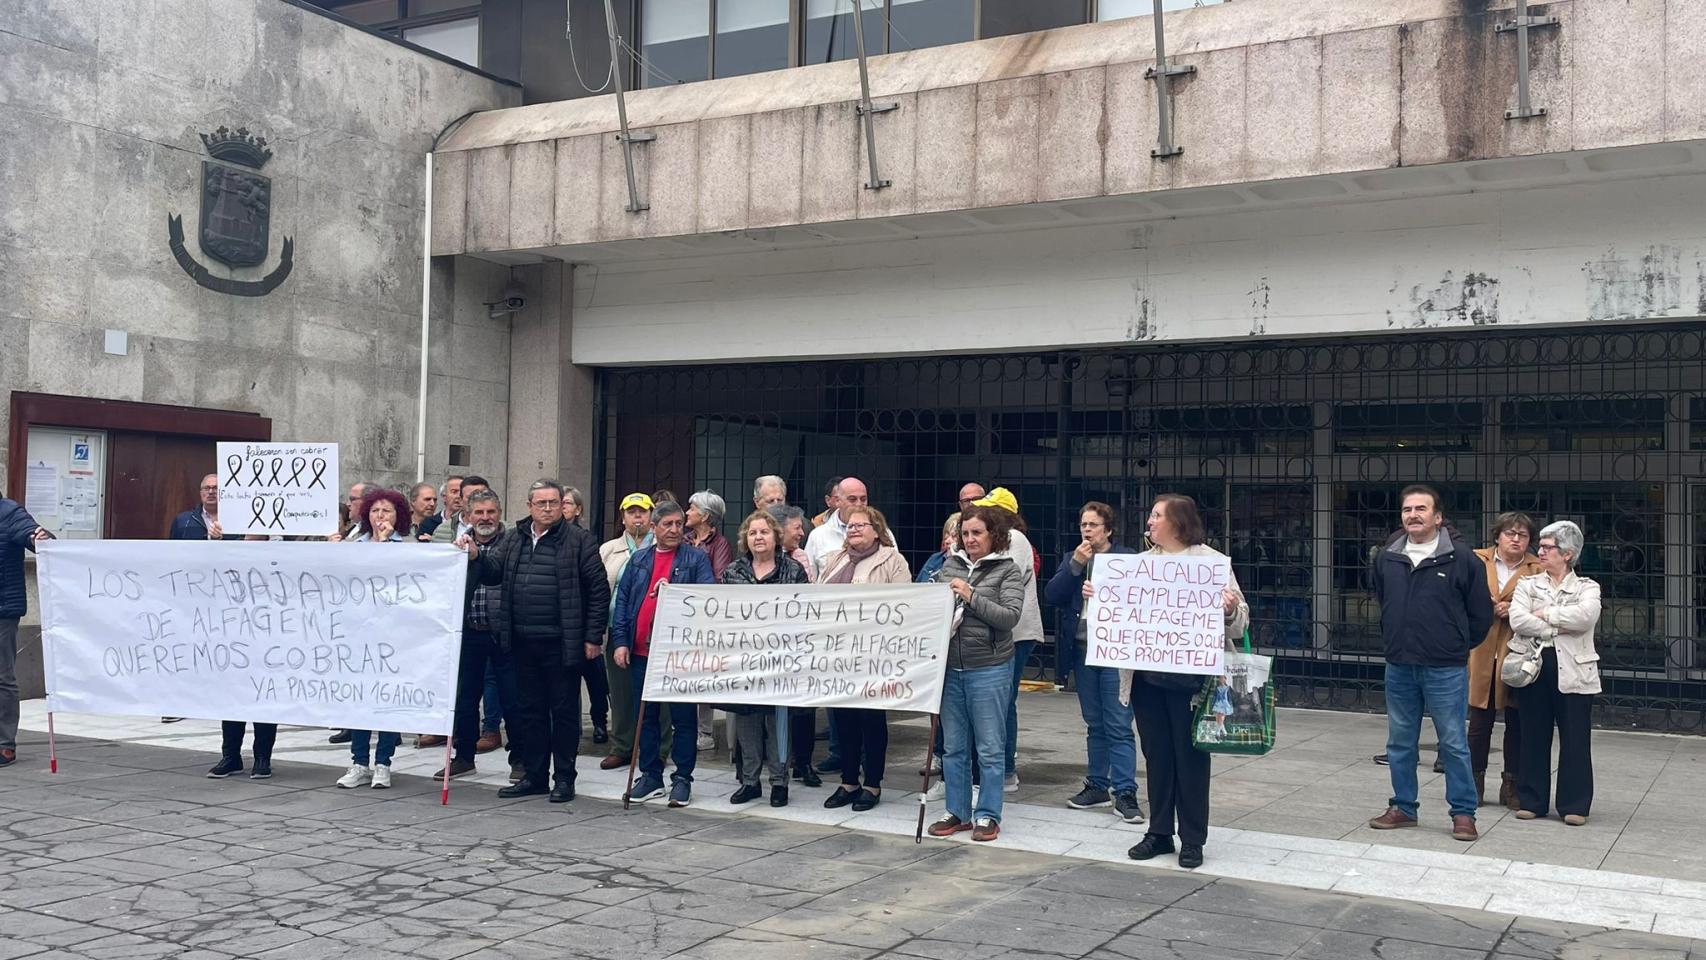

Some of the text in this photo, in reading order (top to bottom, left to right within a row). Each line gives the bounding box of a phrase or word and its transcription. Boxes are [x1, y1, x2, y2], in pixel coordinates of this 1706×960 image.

[88, 561, 428, 613] LOS TRABAJADORES
[1098, 585, 1121, 603] OS
[681, 593, 910, 626] SOLUCIÓN A LOS
[1097, 606, 1221, 629] DE ALFAGEME
[136, 606, 345, 642] DE ALFAGEME
[1095, 626, 1190, 646] QUEREMOS
[668, 625, 816, 654] TRABAJADORES
[824, 632, 847, 651] DE
[103, 641, 400, 677] QUEREMOS COBRAR
[665, 650, 907, 677] ALCALDE PEDIMOS LO QUE NOS
[1096, 645, 1217, 667] NOS PROMETEU
[250, 676, 436, 708] YA PASARON 16 AÑOS
[773, 677, 798, 694] HAN
[808, 676, 856, 696] PASADO
[861, 681, 876, 699] 16
[881, 678, 913, 699] AÑOS
